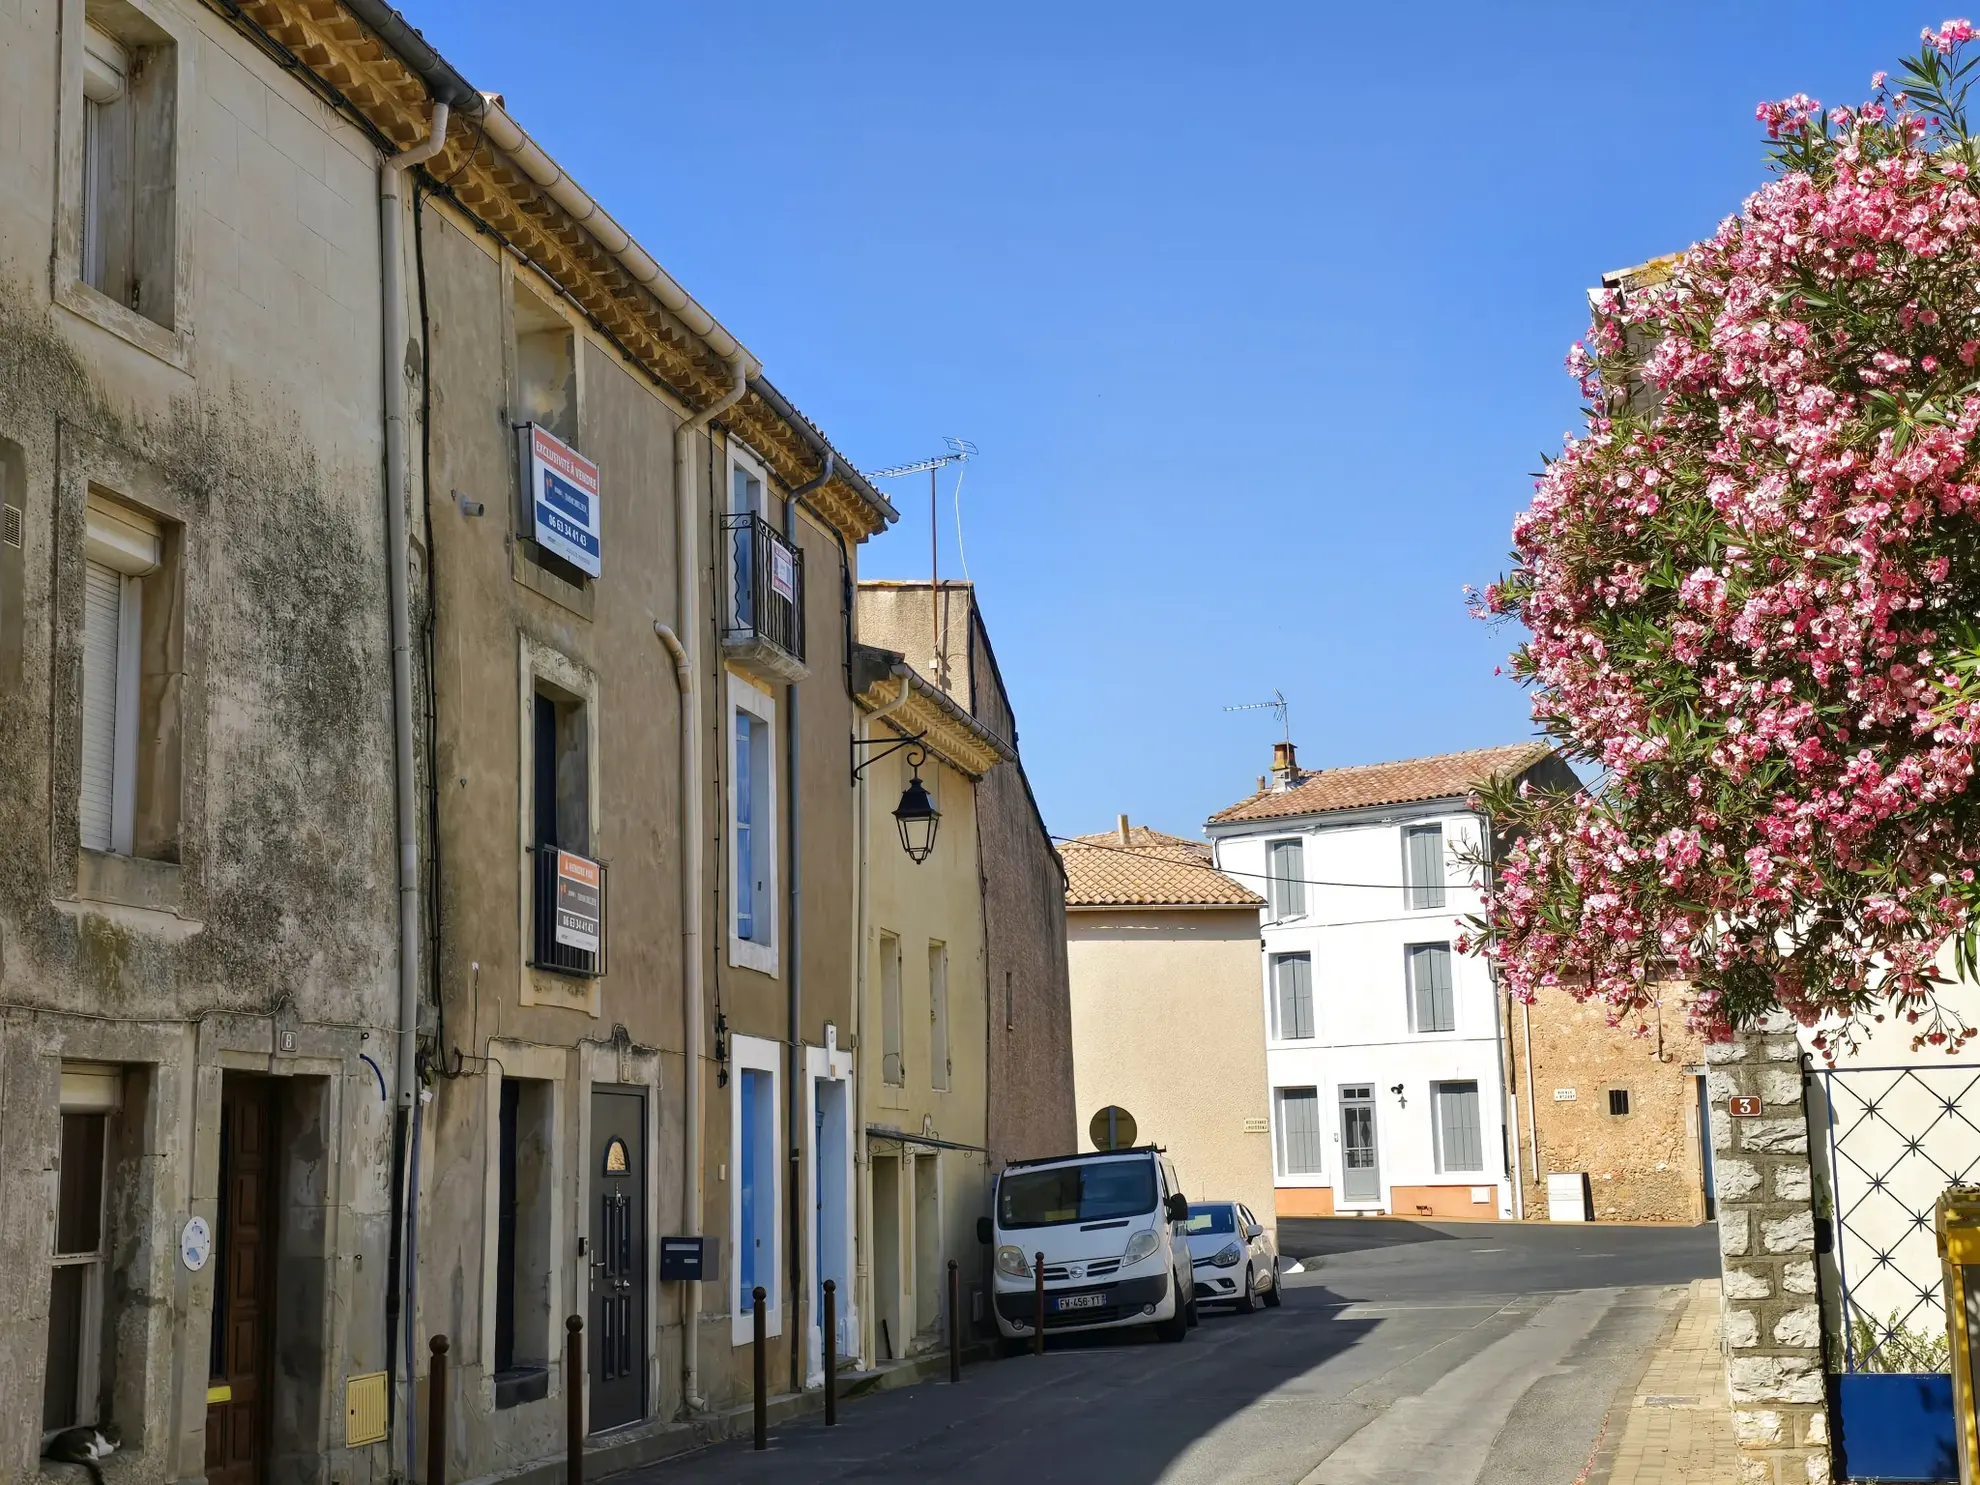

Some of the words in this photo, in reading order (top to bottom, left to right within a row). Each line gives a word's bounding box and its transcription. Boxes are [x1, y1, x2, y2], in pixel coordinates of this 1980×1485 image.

[548, 514, 557, 528] 06
[557, 519, 564, 533] 63
[564, 523, 572, 537] 34
[572, 528, 579, 542] 41
[579, 533, 587, 547] 43
[1740, 1098, 1752, 1114] 3
